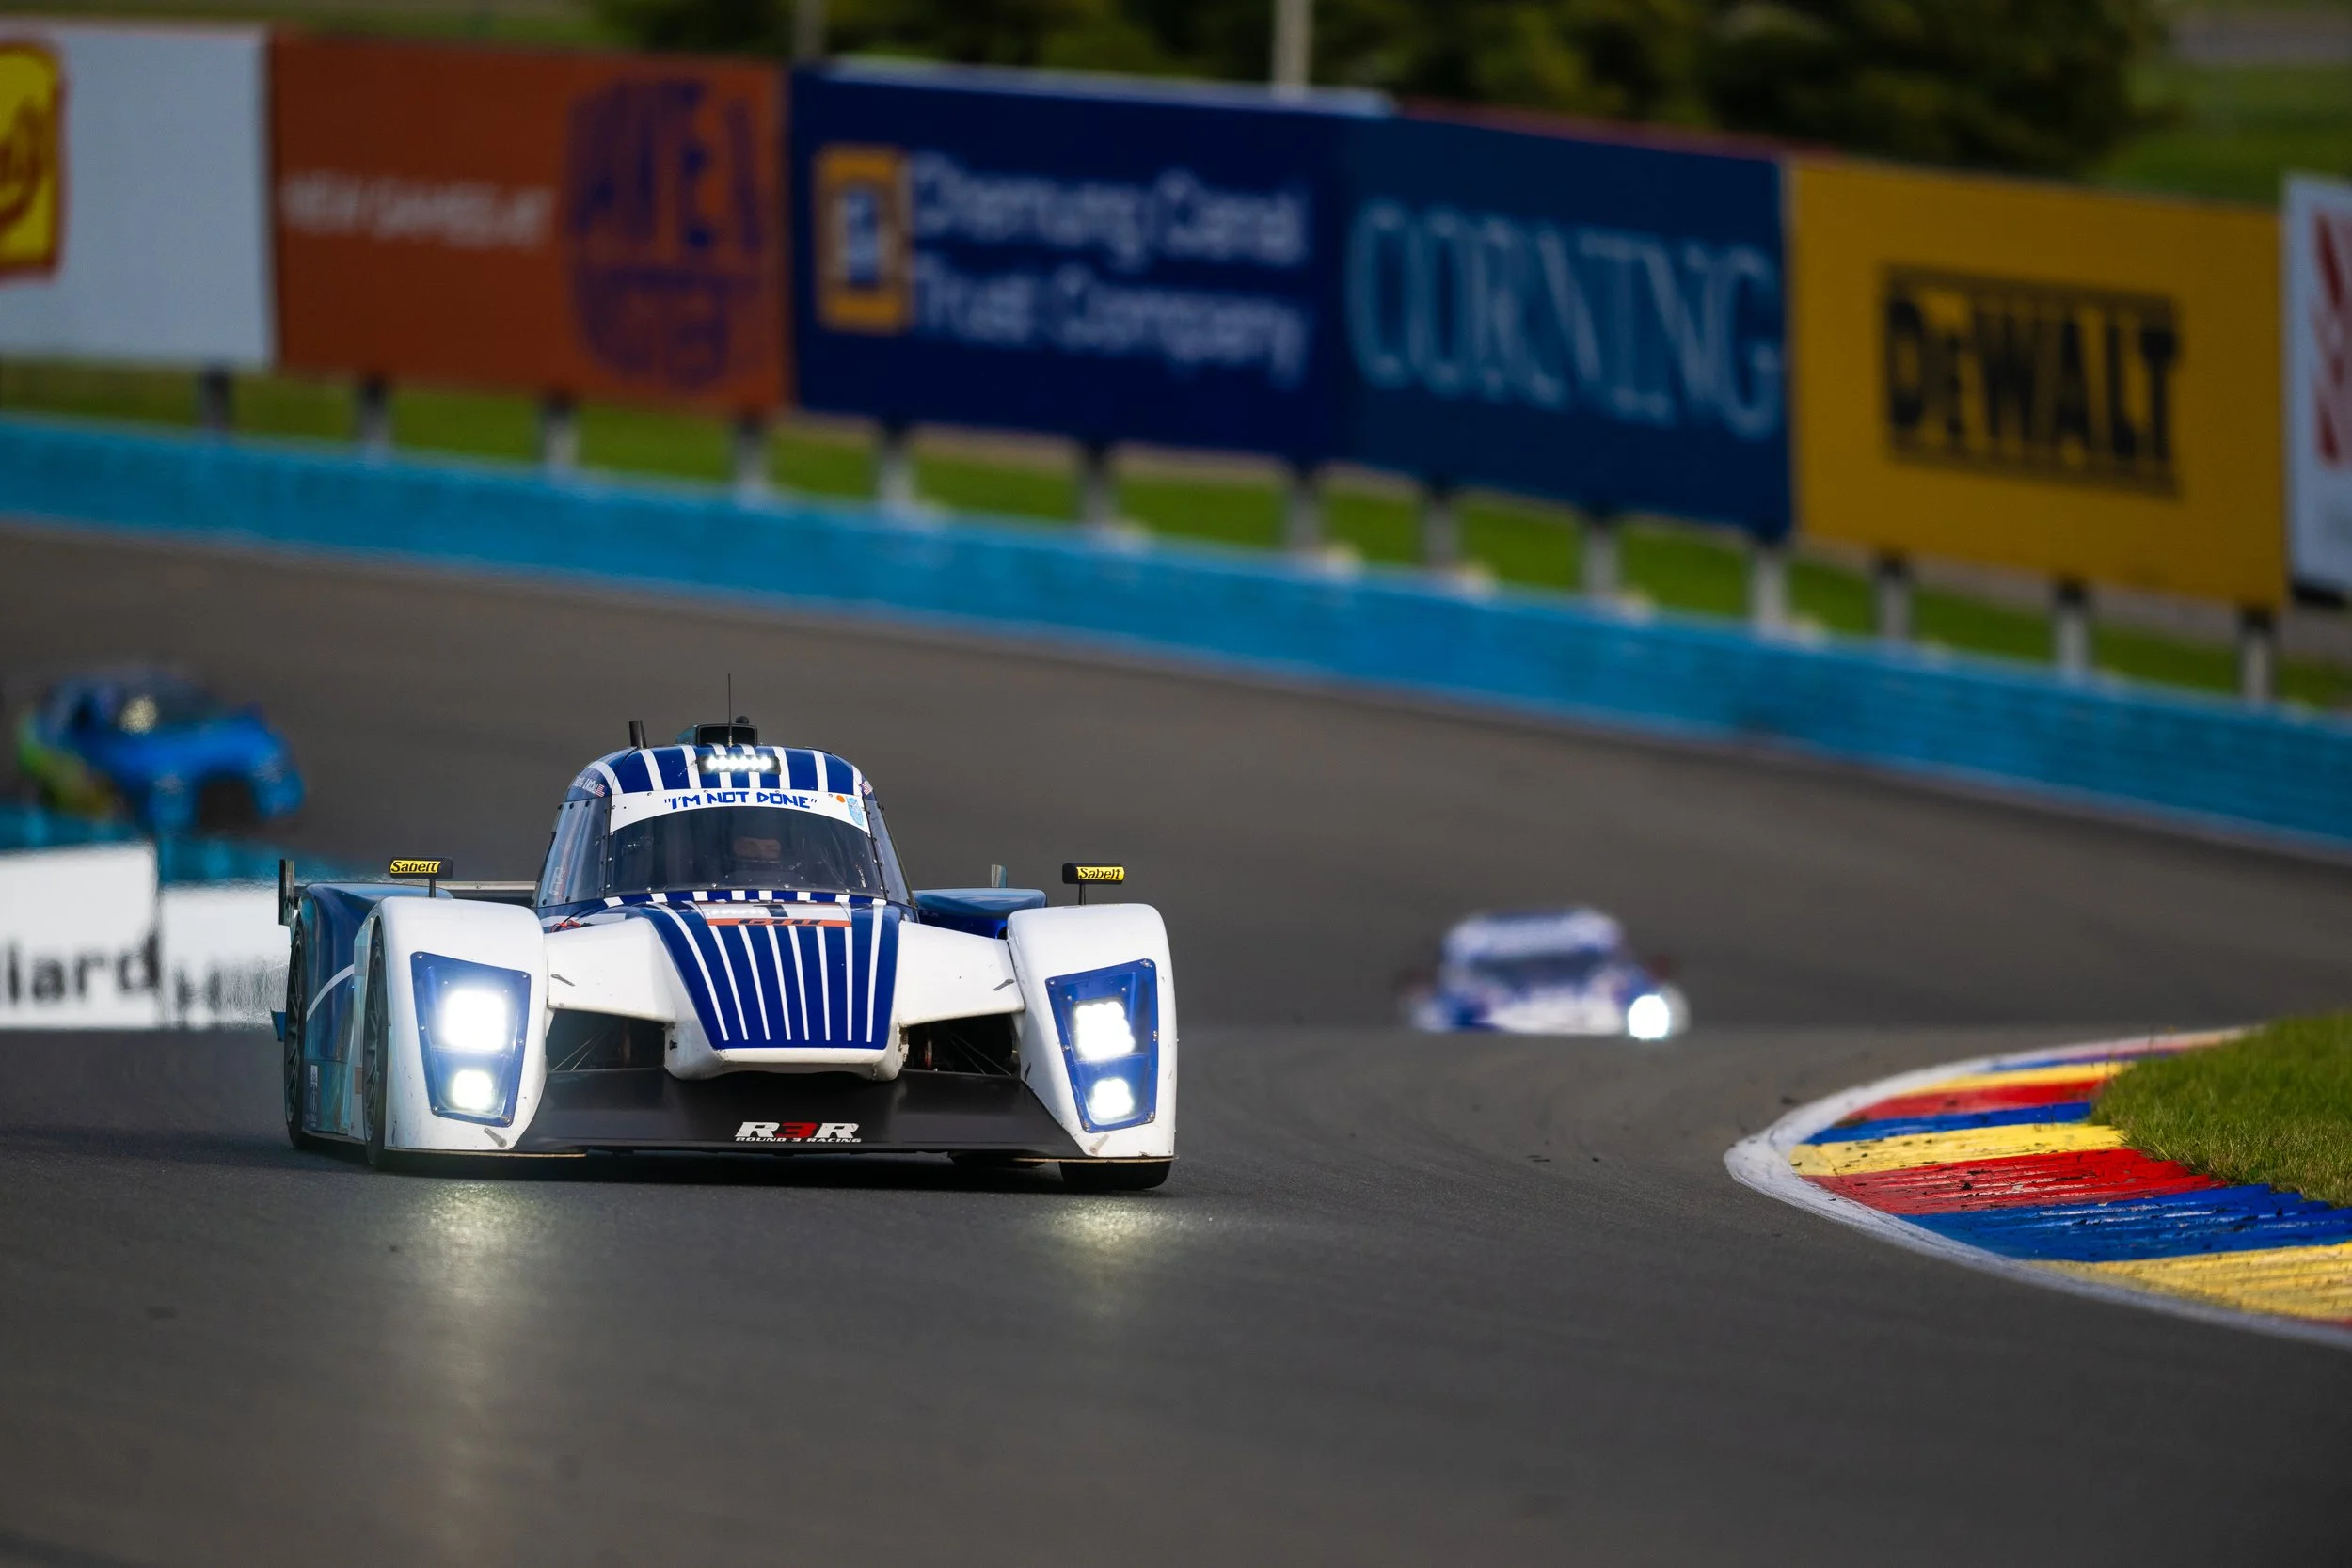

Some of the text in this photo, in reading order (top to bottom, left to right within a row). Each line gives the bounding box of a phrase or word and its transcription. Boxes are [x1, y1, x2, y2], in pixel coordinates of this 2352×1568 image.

[1347, 200, 1781, 440] CORNING
[707, 791, 750, 804] NOT
[390, 861, 438, 873] Sabelt
[1079, 867, 1121, 879] Sabelt
[735, 1121, 860, 1139] R3R
